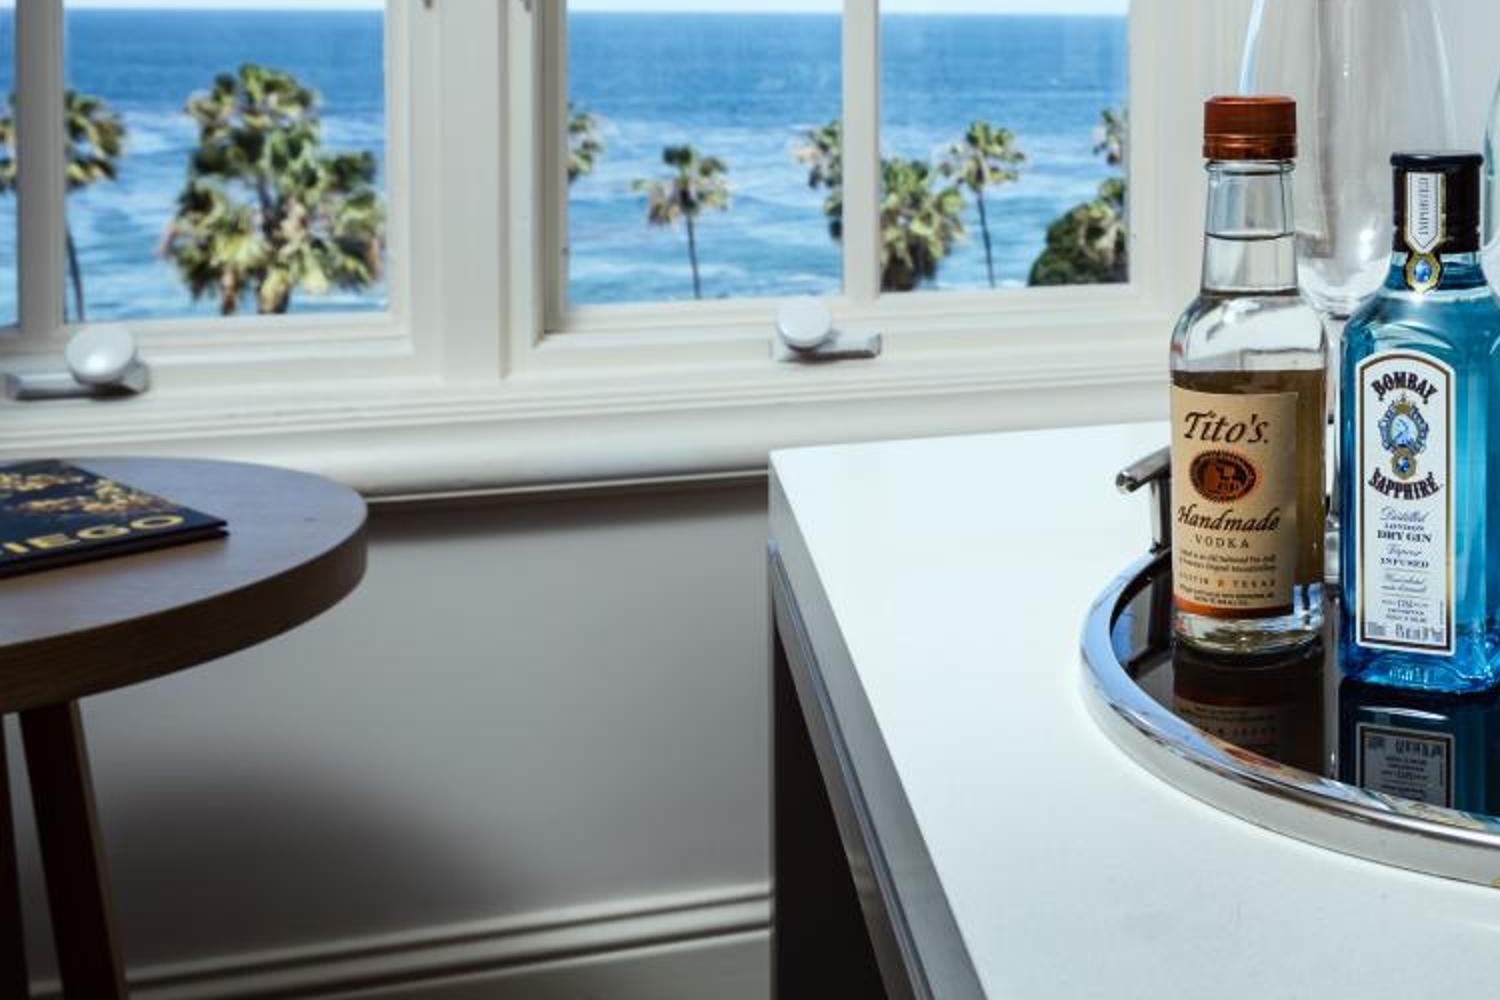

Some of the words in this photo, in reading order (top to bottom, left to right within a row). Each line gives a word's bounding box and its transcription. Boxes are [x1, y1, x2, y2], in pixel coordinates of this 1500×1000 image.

[1371, 371, 1438, 405] BOMBAY
[1184, 410, 1269, 443] Tito's
[1367, 467, 1441, 500] SAPPHIRE
[1177, 503, 1280, 531] Handmade
[1195, 533, 1250, 549] VODKA
[1377, 529, 1404, 542] DRY
[1405, 532, 1432, 543] GIN
[1380, 557, 1430, 569] INFUSED
